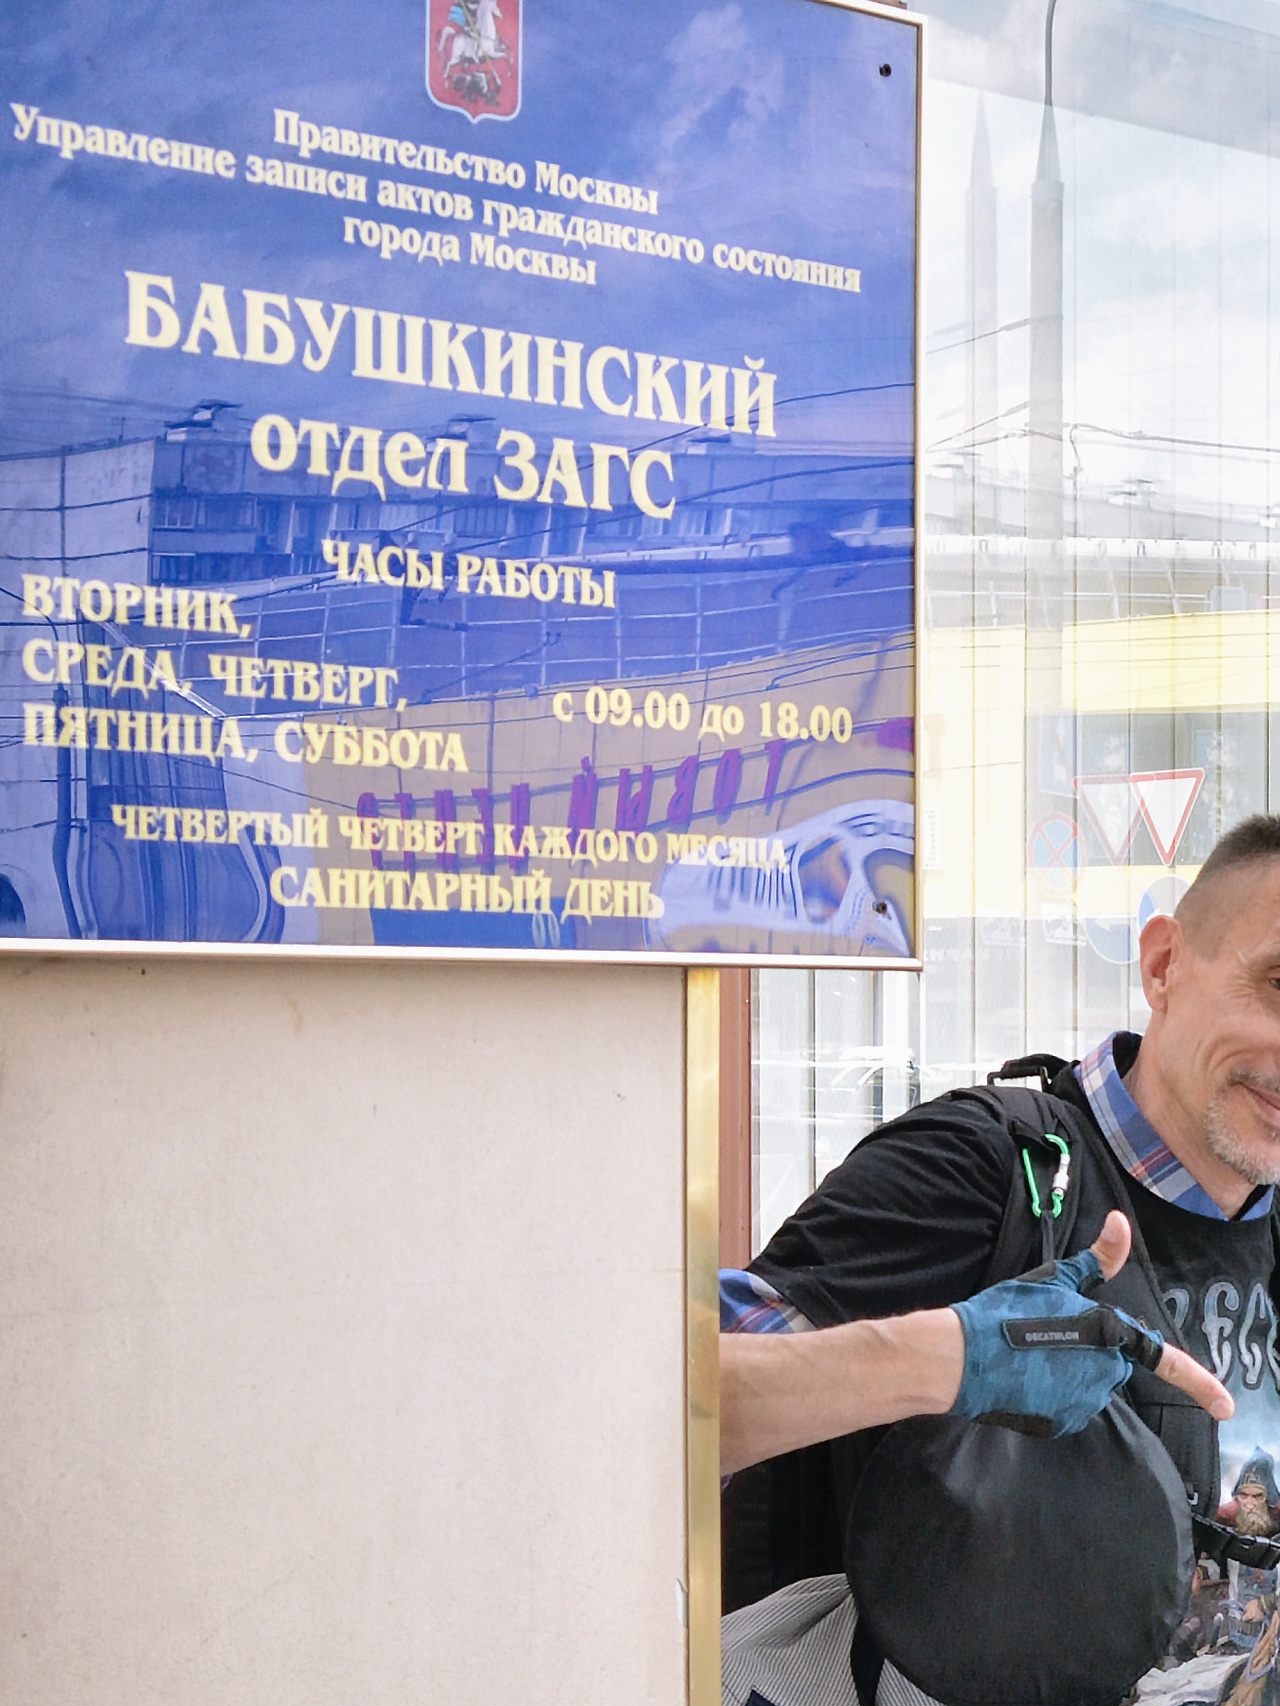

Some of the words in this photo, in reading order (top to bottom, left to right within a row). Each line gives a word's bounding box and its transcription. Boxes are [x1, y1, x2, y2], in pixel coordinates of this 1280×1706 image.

[276, 110, 525, 188] Правительство
[536, 162, 657, 214] Москвы
[14, 105, 235, 177] Управление
[247, 156, 366, 201] записи
[378, 181, 473, 219] актов
[484, 201, 704, 262] гражданского
[713, 244, 860, 292] состояния
[345, 218, 459, 262] города
[471, 233, 595, 284] Москвы
[126, 272, 776, 437] БАБУШКИНСКИЙ
[252, 415, 468, 499] отдел
[495, 430, 675, 518] ЗАГС
[24, 574, 250, 637] ВТОРНИК,
[323, 540, 443, 590] ЧАСЫ
[458, 555, 614, 607] РАБОТЫ
[23, 639, 191, 696] СРЕДА,
[210, 655, 406, 712] ЧЕТВЕРГ,
[24, 704, 258, 763] ПЯТНИЦА,
[275, 721, 469, 773] СУББОТА
[553, 692, 574, 723] с
[585, 686, 691, 731] 09.00
[698, 704, 744, 742] до
[759, 701, 852, 743] 18.00
[114, 806, 329, 848] ЧЕТВЕРТЫЙ
[338, 816, 484, 855] ЧЕТВЕРГ
[494, 824, 658, 869] КАЖДОГО
[666, 833, 787, 875] МЕСЯЦА
[270, 866, 552, 914] САНИТАРНЫЙ
[562, 878, 664, 923] ДЕНЬ
